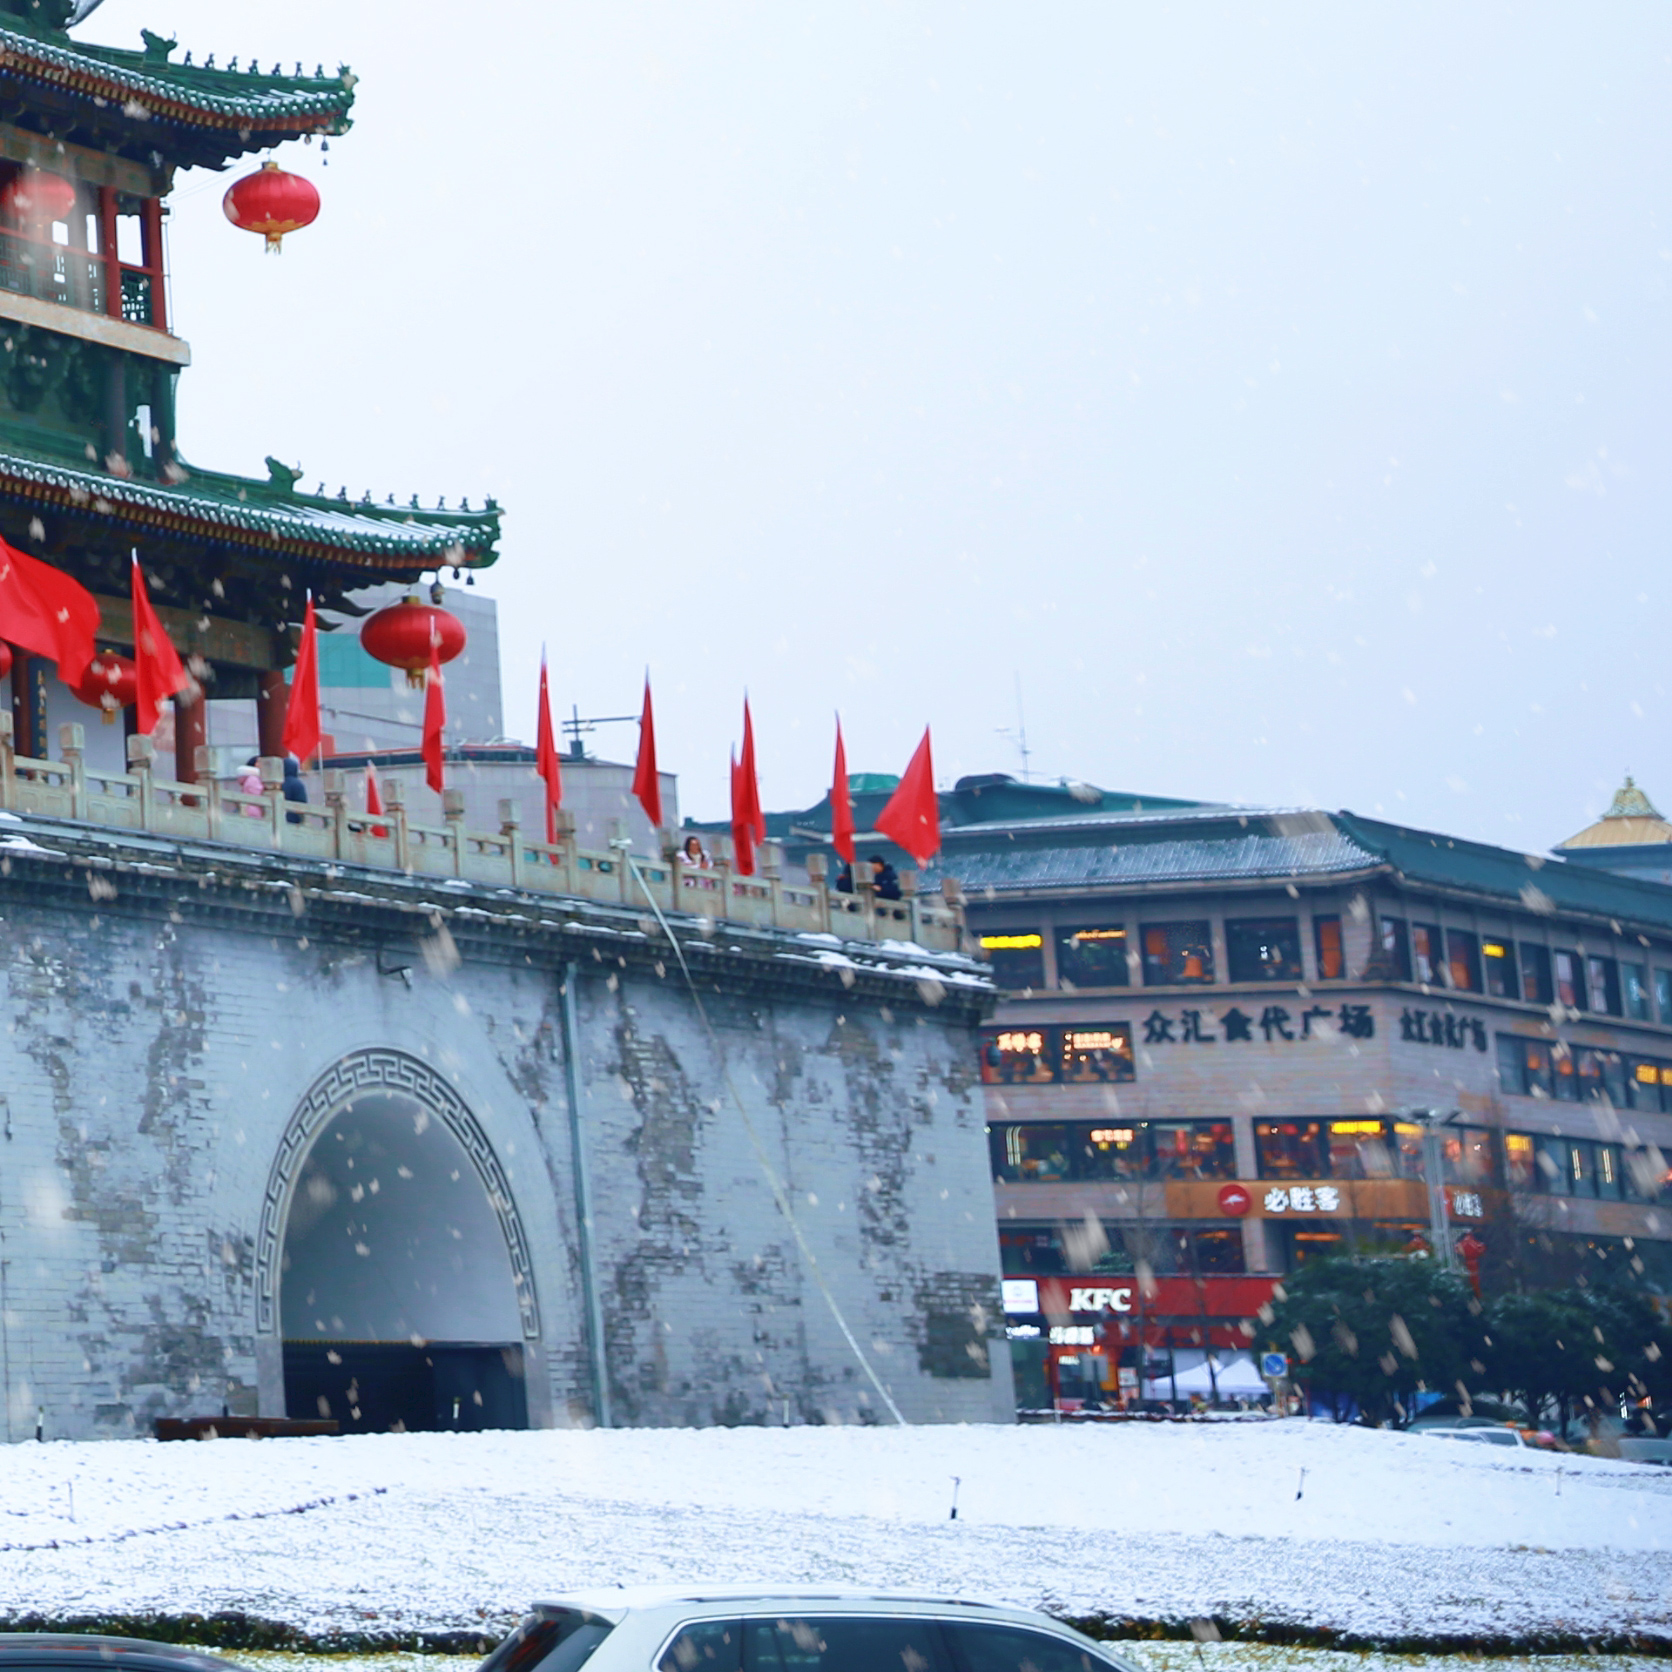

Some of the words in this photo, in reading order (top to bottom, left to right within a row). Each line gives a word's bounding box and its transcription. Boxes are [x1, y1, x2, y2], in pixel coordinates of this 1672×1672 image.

[1142, 1003, 1375, 1044] 众汇食代广场
[1264, 1186, 1340, 1213] 必胜客
[1068, 1287, 1132, 1312] KFC
